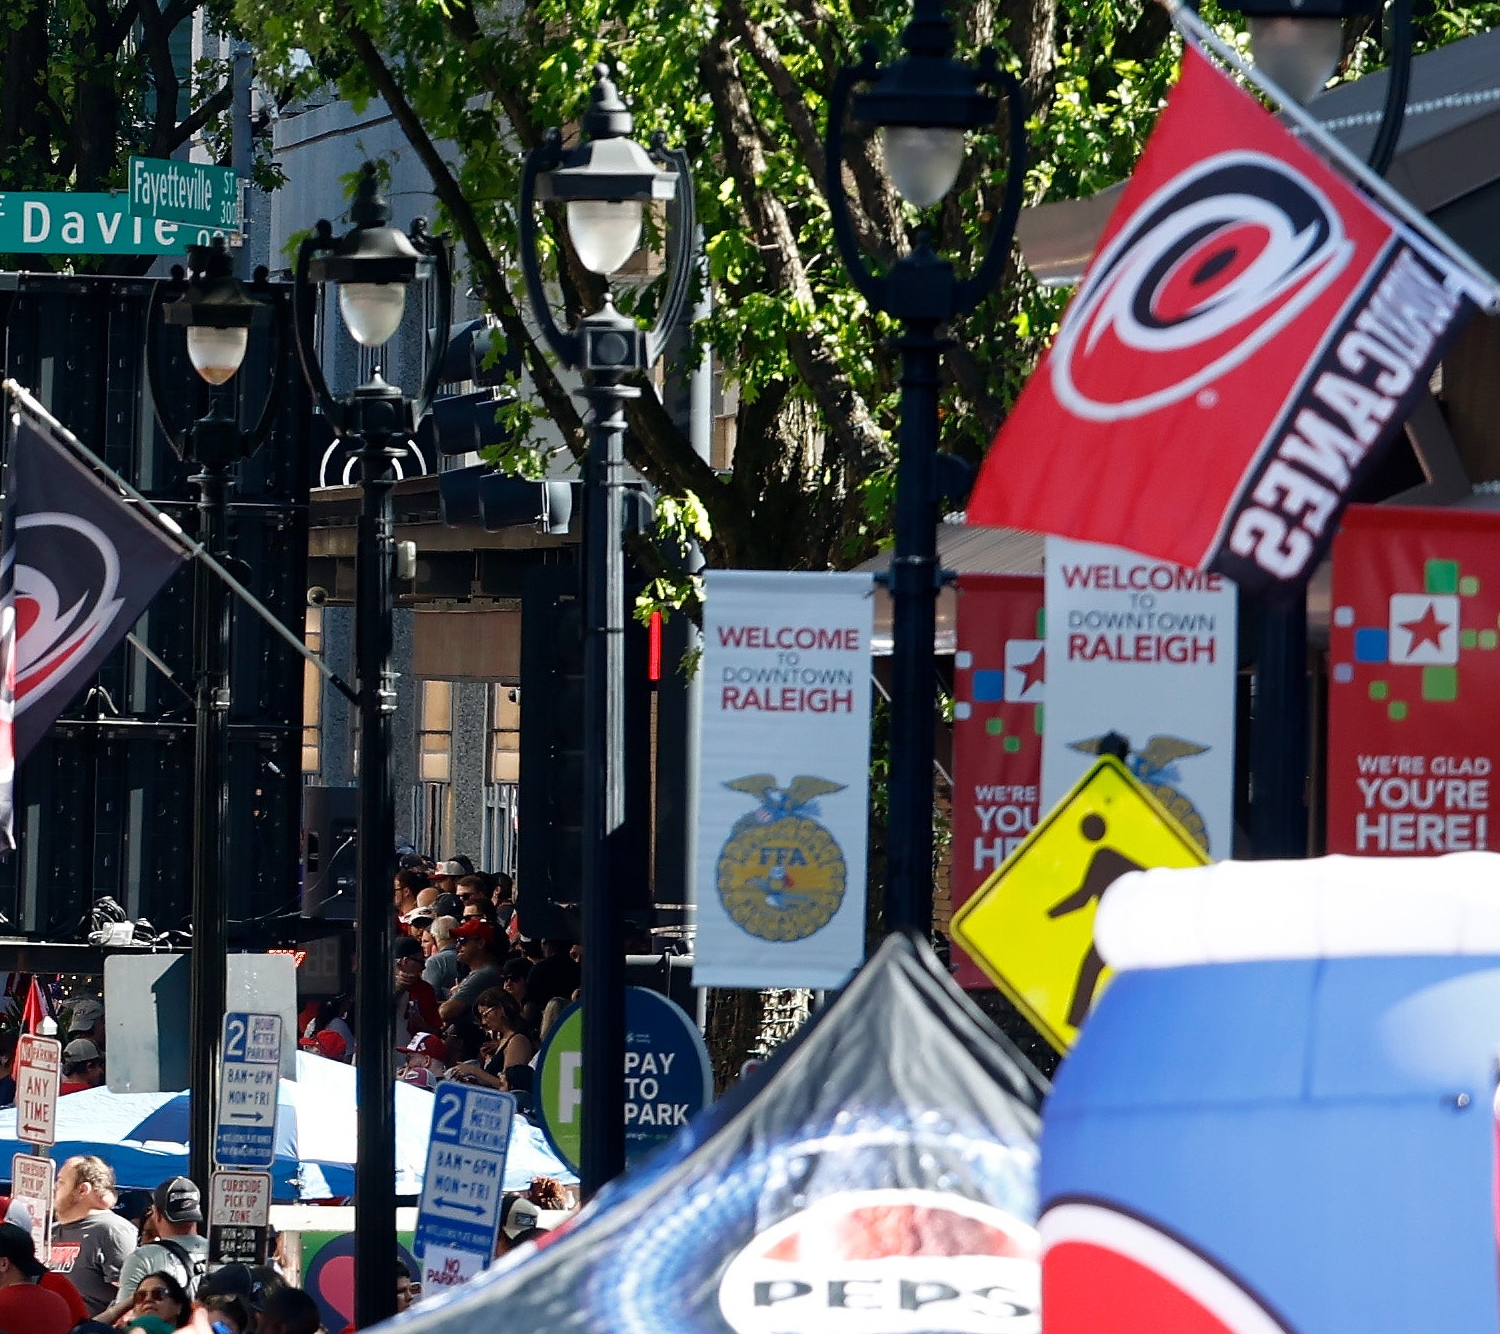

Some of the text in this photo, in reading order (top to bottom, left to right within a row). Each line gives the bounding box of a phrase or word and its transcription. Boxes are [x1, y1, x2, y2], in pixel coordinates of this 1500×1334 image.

[134, 161, 235, 217] Fayetteville ST
[1062, 565, 1223, 593] WELCOME
[1131, 593, 1155, 608] TO
[1068, 610, 1215, 631] DOWNTOWN
[717, 625, 860, 651] WELCOME
[778, 652, 799, 667] TO
[1067, 634, 1216, 664] RALEIGH
[722, 667, 852, 686] DOWNTOWN
[721, 686, 853, 714] RALEIGH
[1357, 755, 1492, 776] WE'RE GLAD
[975, 785, 1036, 801] WE'RE
[1356, 777, 1490, 810] YOU'RE
[1356, 813, 1488, 851] HERE!
[227, 1019, 244, 1055] 2
[253, 1033, 275, 1045] METER
[246, 1047, 279, 1061] PARKING
[624, 1052, 675, 1075] PAY
[26, 1076, 48, 1097] ANY
[227, 1069, 274, 1085] 8AM-6PM
[228, 1091, 270, 1106] MON-FRI
[624, 1078, 659, 1100] TO
[24, 1100, 49, 1123] TIME
[436, 1093, 462, 1137] 2
[624, 1103, 690, 1126] PARK
[436, 1151, 498, 1178] 8AM-6PM
[22, 1178, 44, 1193] PICK UP
[221, 1179, 262, 1193] CURBSIDE
[434, 1174, 490, 1201] MON-FRI
[224, 1195, 258, 1208] PICK UP
[230, 1209, 250, 1223] ZONE
[220, 1228, 256, 1240] MON-SUN
[444, 1257, 461, 1274] NO
[752, 1279, 1038, 1319] PEPS
